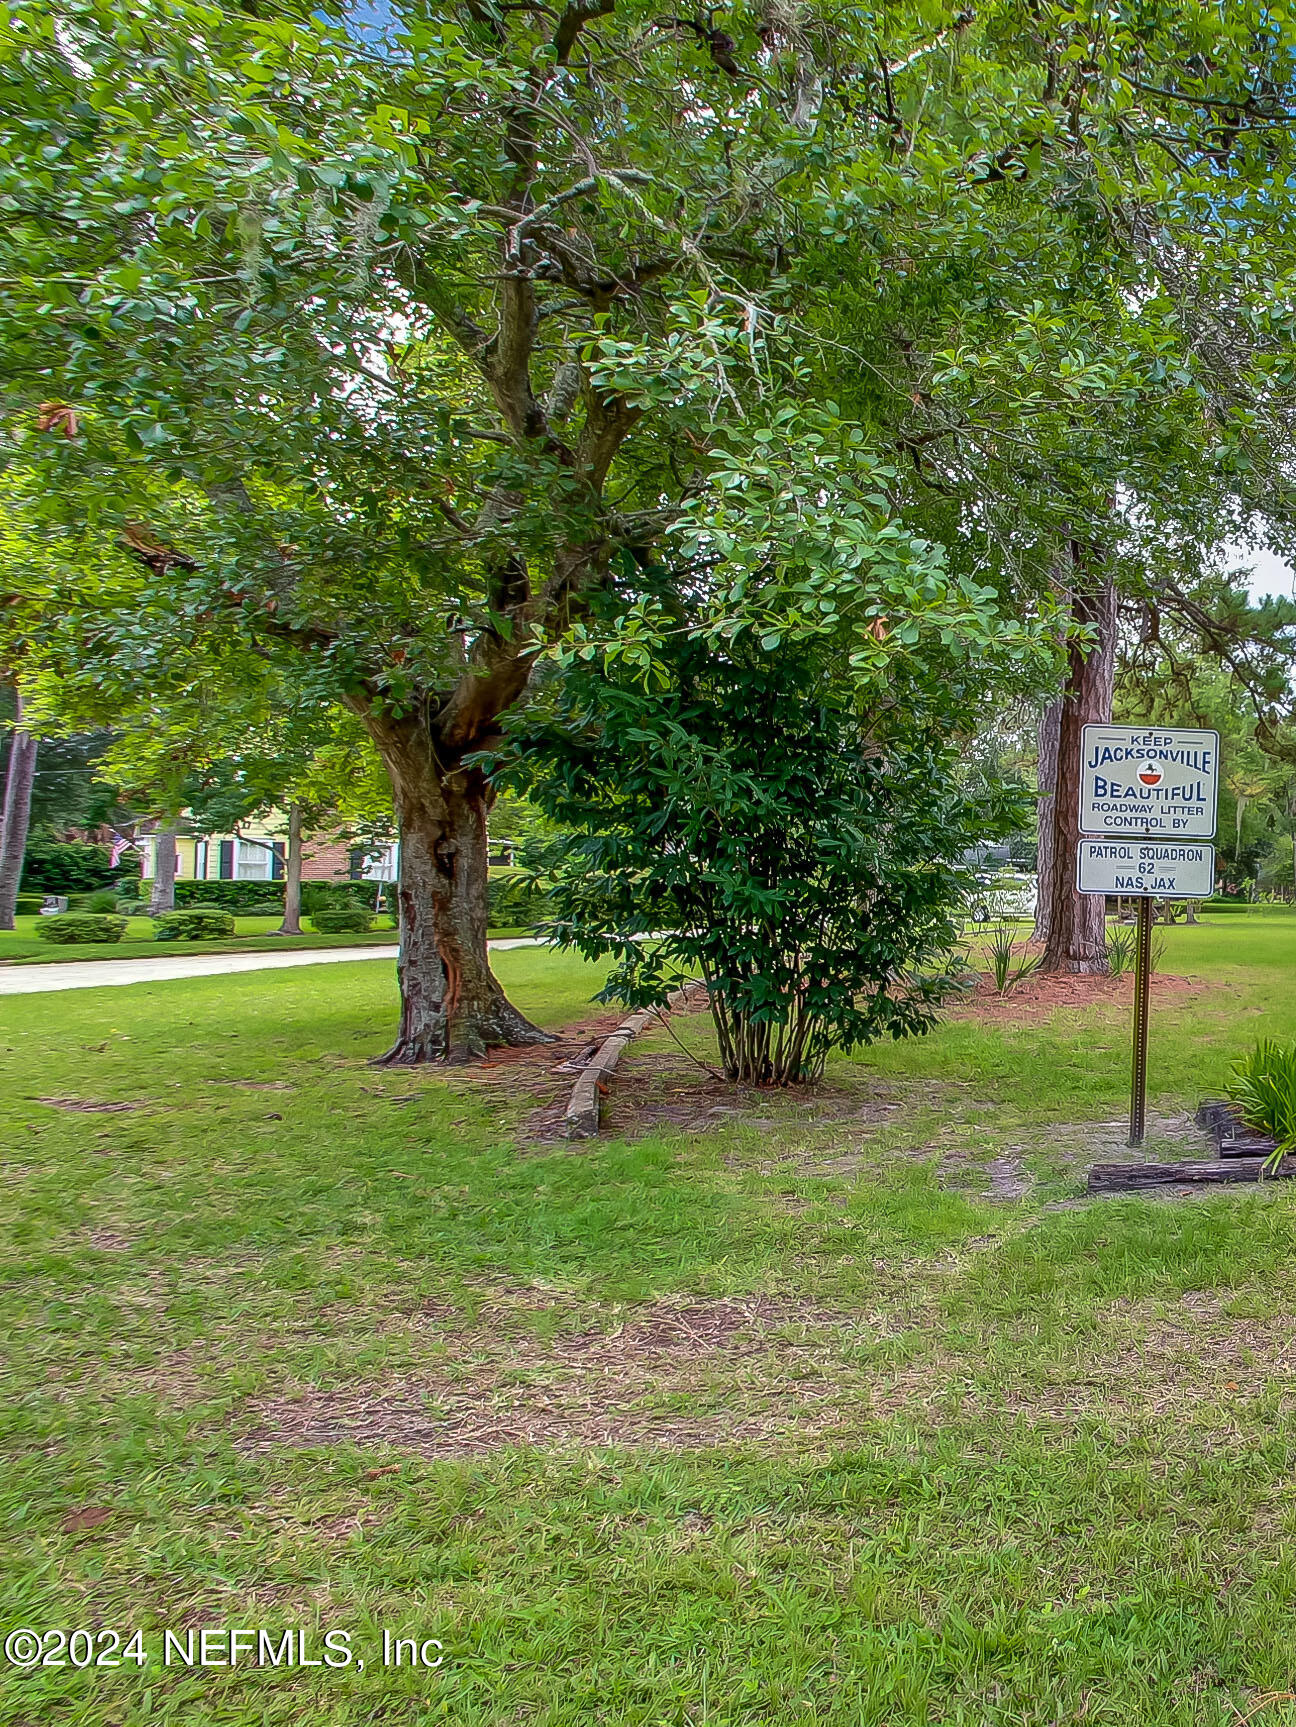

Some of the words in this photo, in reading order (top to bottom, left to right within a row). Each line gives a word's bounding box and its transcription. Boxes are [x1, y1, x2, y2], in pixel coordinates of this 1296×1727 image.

[1131, 735, 1173, 747] KEEP
[1088, 746, 1211, 775] JACKSONVILLE
[1094, 774, 1206, 802] BEAUTIFUL
[1092, 802, 1154, 814] ROADWAY
[1160, 805, 1204, 816] LITTER
[1103, 815, 1166, 828] CONTROL
[1172, 818, 1189, 829] BY
[1089, 845, 1134, 860] PATROL
[1139, 848, 1203, 862] SQUADRON
[1138, 862, 1155, 875] 62
[1150, 877, 1176, 890] JAX
